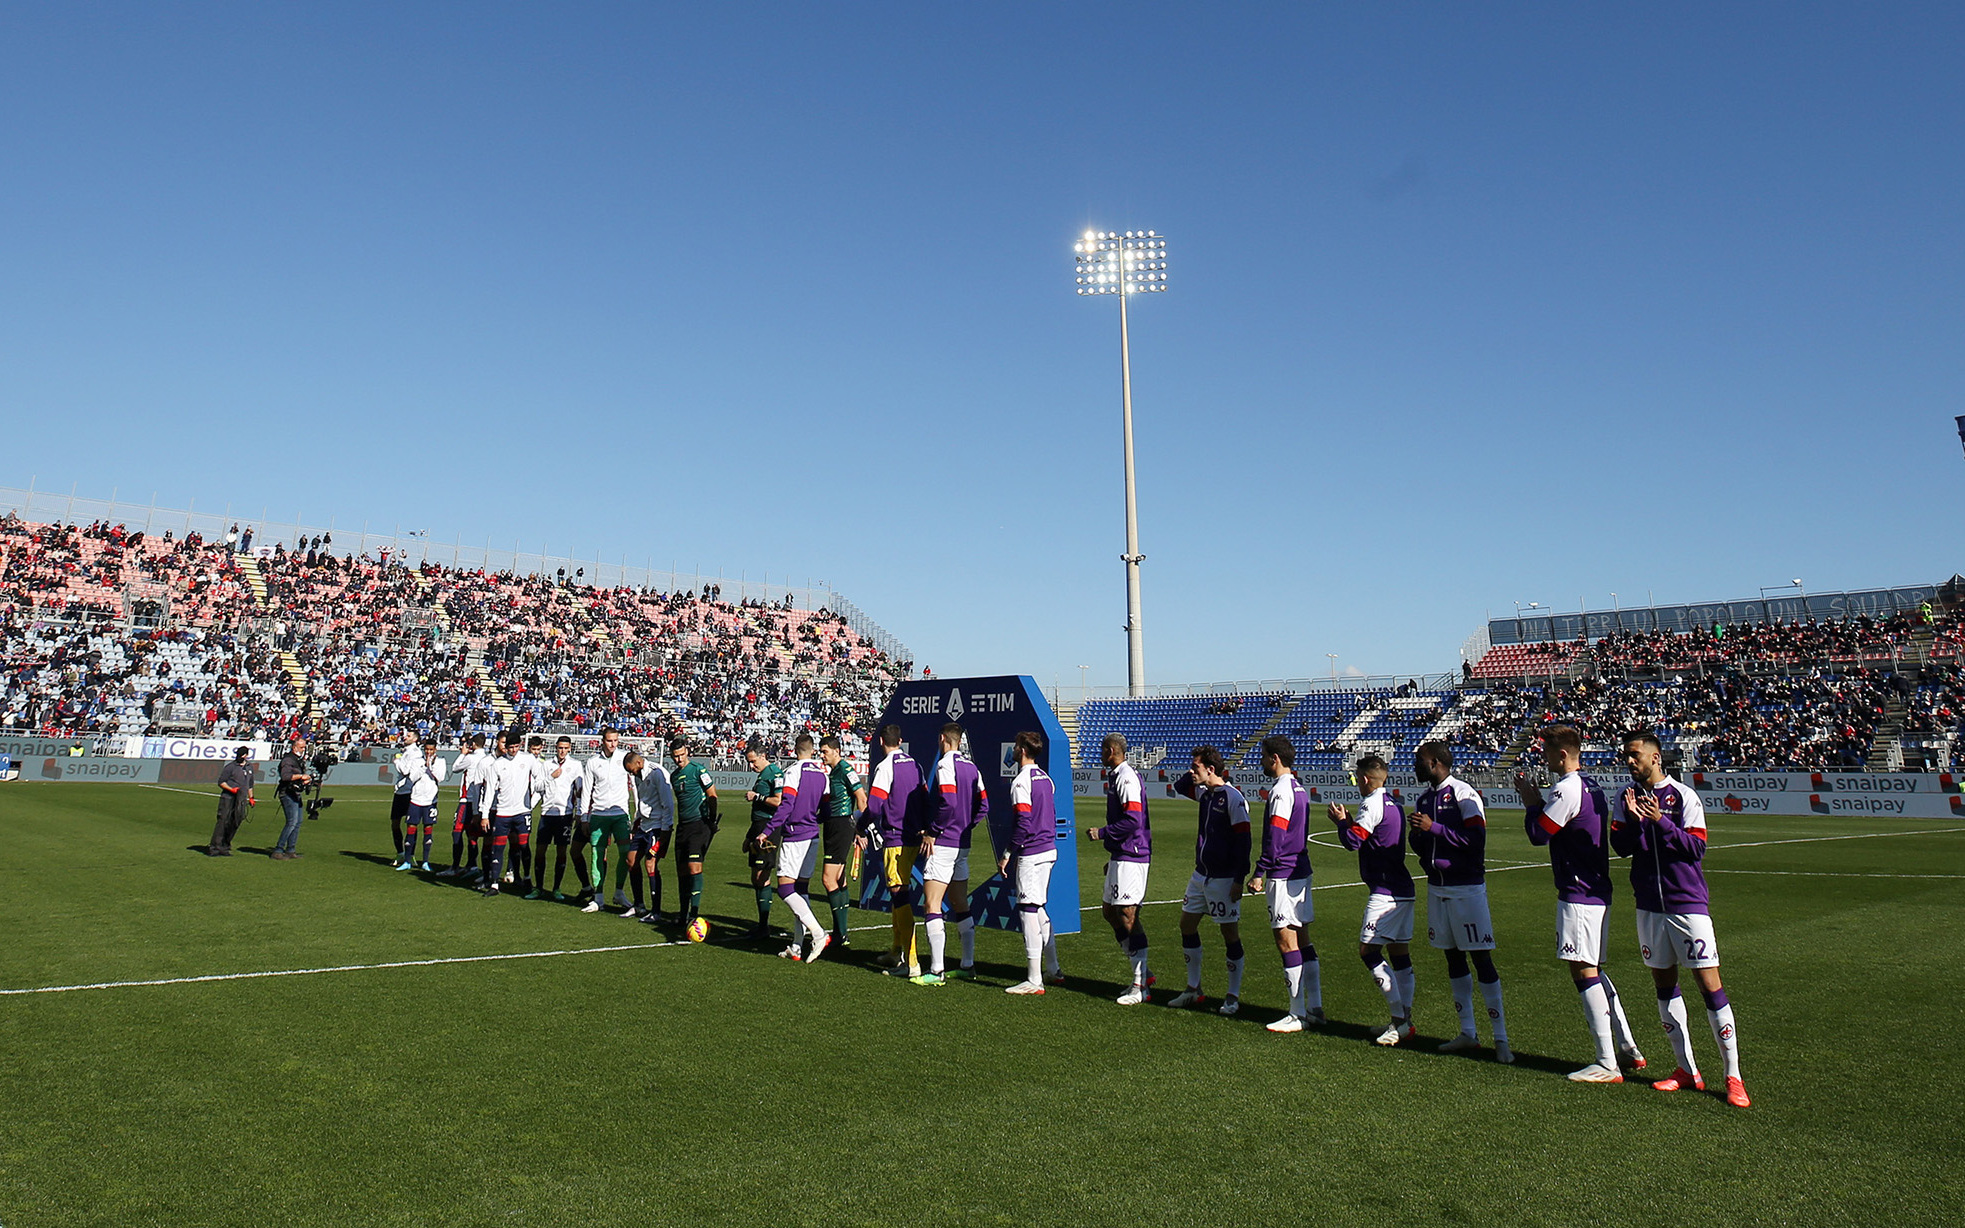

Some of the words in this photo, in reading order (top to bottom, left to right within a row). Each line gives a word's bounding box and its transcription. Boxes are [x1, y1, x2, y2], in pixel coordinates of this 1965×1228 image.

[902, 696, 940, 714] SERIE
[987, 693, 1014, 712] TIM
[66, 761, 142, 779] snaipay
[1236, 772, 1272, 787] snaipa
[1716, 775, 1788, 791] snaipay
[1836, 777, 1917, 793] snaipay
[1832, 796, 1905, 813] snaipay
[1210, 902, 1226, 917] 29
[1464, 923, 1479, 943] 11
[1684, 939, 1709, 960] 22
